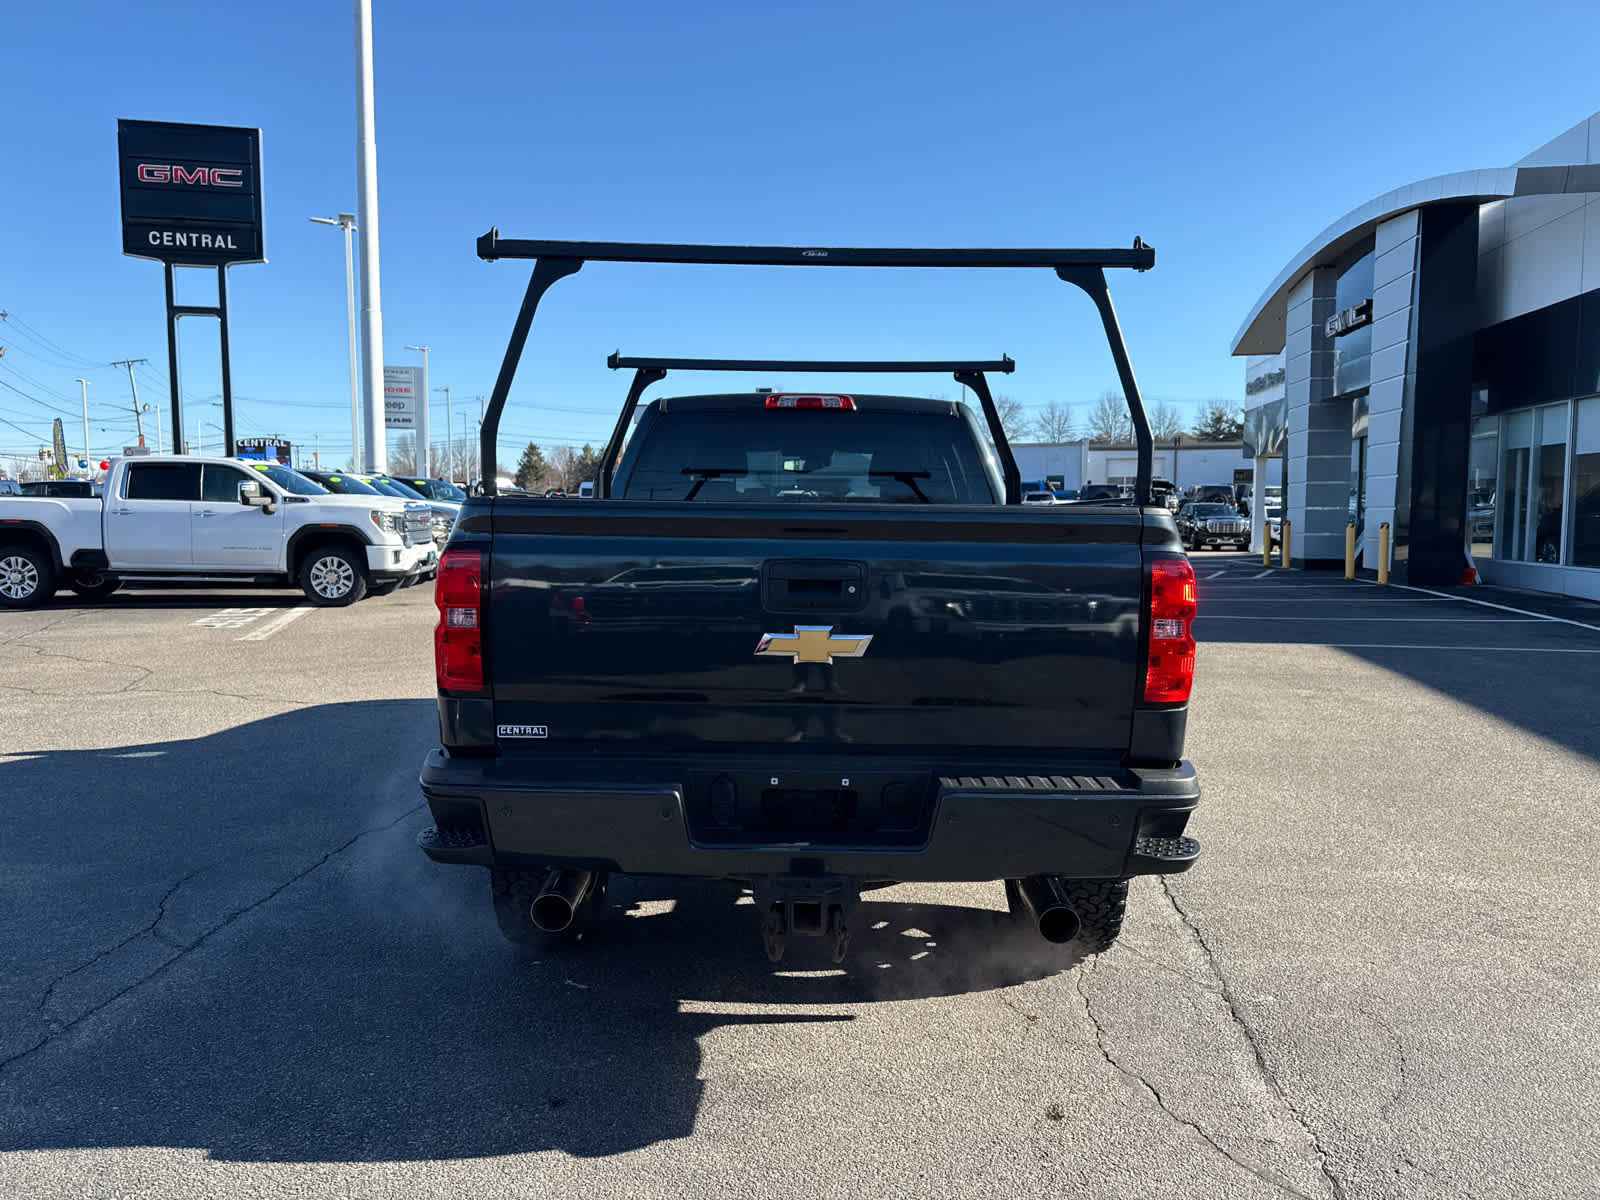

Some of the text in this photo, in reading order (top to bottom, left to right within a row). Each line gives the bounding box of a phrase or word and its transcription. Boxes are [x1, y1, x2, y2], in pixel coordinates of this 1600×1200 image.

[137, 163, 243, 187] GMC
[148, 230, 238, 249] CENTRAL
[1325, 299, 1367, 338] GMC
[237, 439, 288, 447] CENTRAL
[500, 727, 545, 735] CENTRAL
